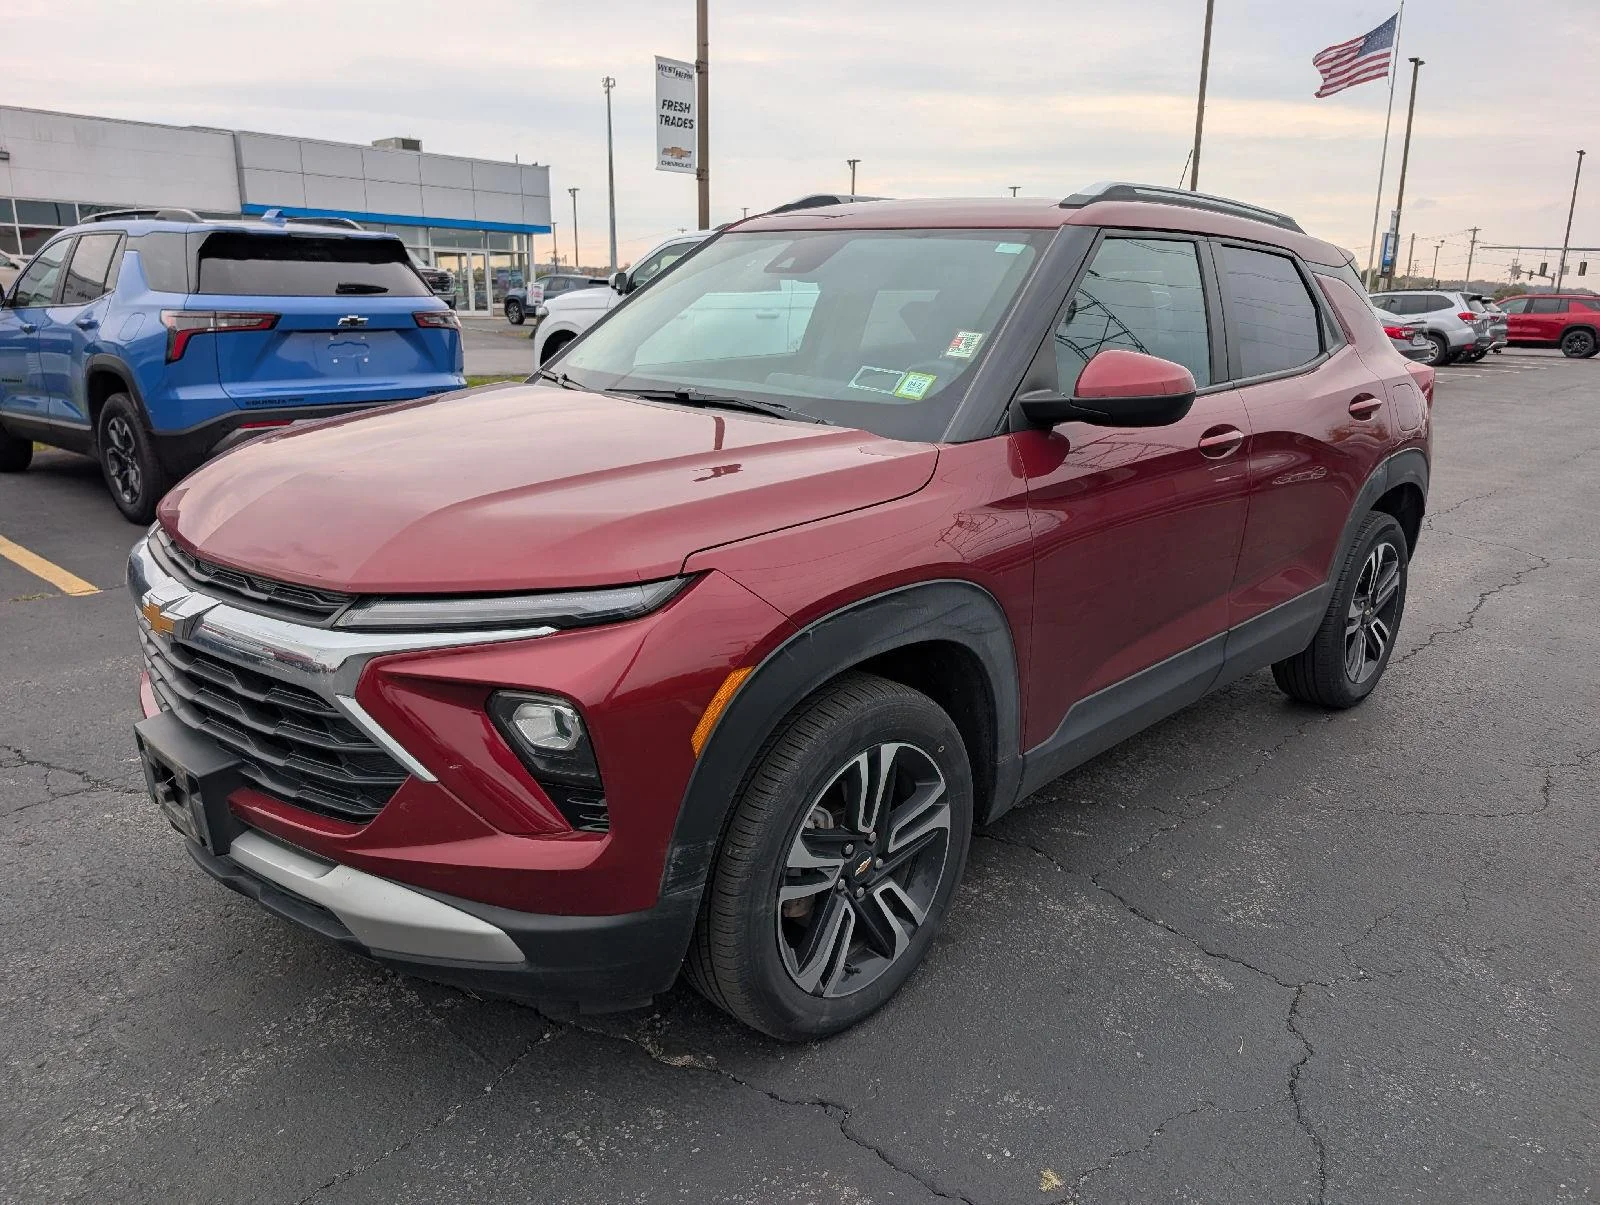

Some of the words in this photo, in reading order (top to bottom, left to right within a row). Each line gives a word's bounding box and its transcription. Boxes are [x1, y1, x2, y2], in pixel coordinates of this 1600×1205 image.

[661, 99, 691, 114] FRESH
[659, 114, 694, 129] TRADES
[660, 160, 692, 169] CHEVROLET
